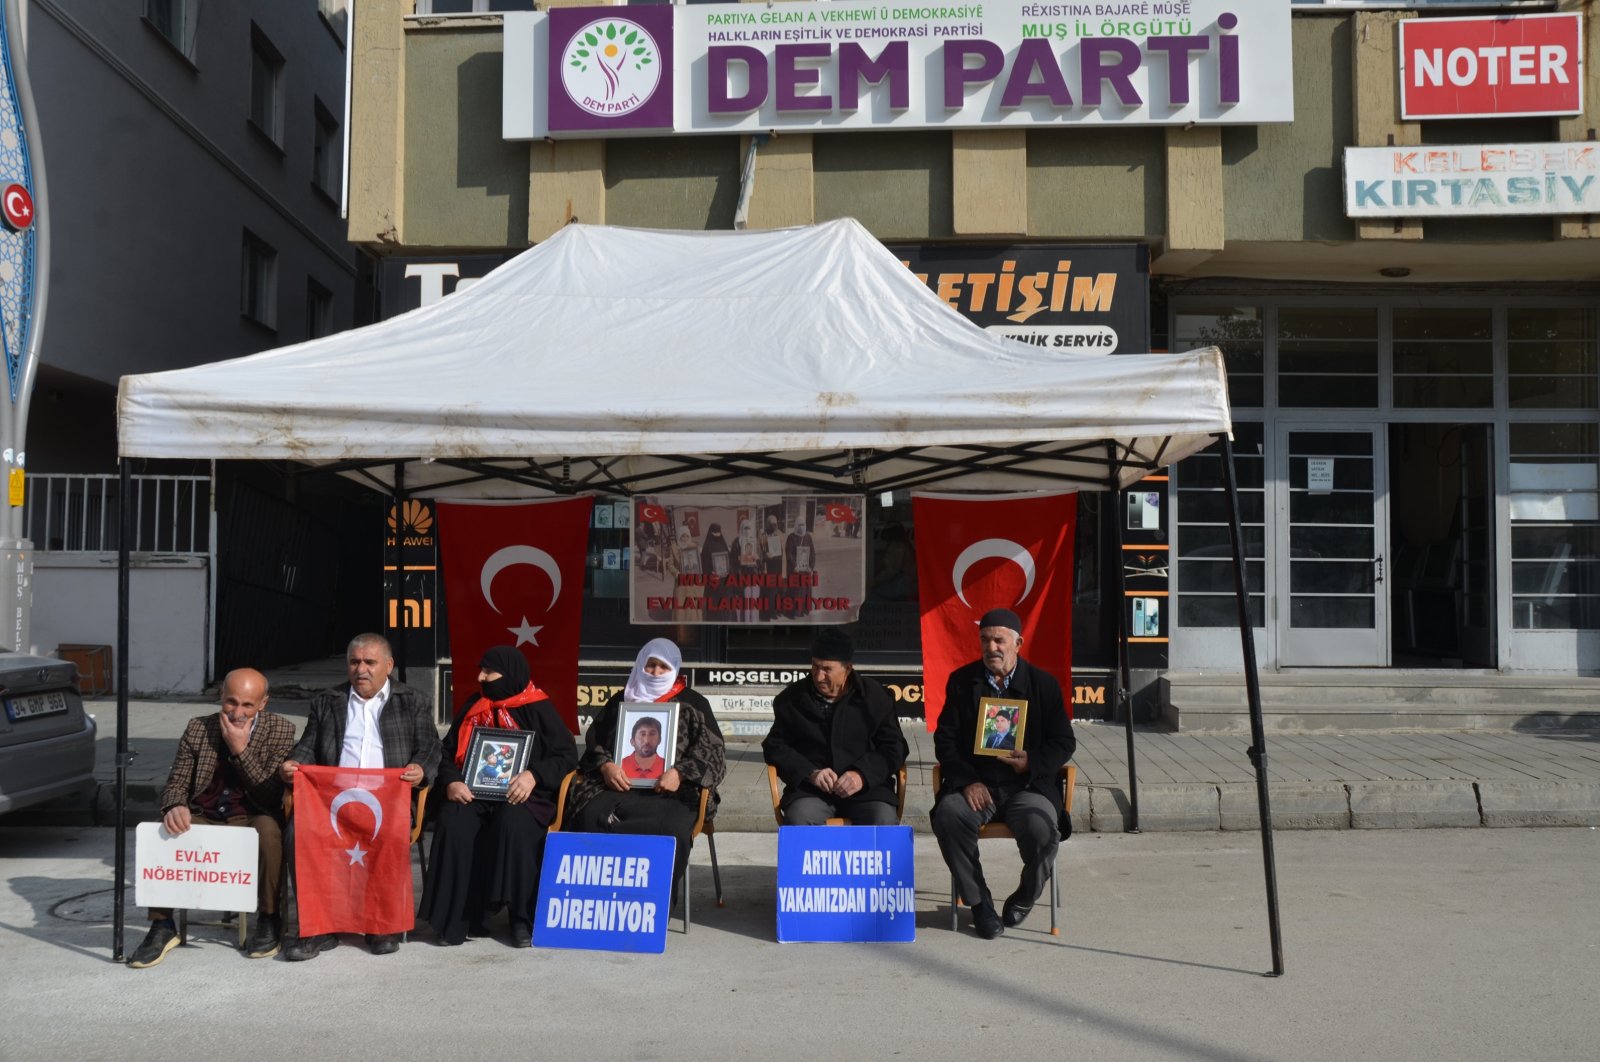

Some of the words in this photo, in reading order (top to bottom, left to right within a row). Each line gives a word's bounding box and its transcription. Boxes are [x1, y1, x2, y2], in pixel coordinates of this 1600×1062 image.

[707, 13, 757, 25] PARTIYA
[760, 11, 803, 24] GELAN
[807, 11, 817, 22] A
[880, 6, 888, 20] Û
[1021, 4, 1092, 17] RÊXISTINA
[1095, 1, 1149, 16] BAJARÊ
[708, 30, 781, 42] HALKLARIN
[784, 26, 832, 42] EŞİTLİK
[836, 28, 852, 39] VE
[855, 24, 928, 38] DEMOKRASİ
[933, 23, 983, 36] PARTİSİ
[1022, 23, 1068, 40] MUŞ
[1075, 20, 1094, 37] İL
[1100, 18, 1192, 37] ÖRGÜTÜ
[708, 41, 909, 116] DEM
[943, 12, 1240, 108] PARTİ
[1413, 45, 1570, 87] NOTER
[582, 96, 606, 112] DEM
[608, 93, 640, 112] PARTİ
[1053, 331, 1114, 348] SERVİS
[387, 537, 433, 546] HAWEI
[677, 573, 720, 590] MUŞ
[725, 572, 819, 588] ANNELERİ
[646, 596, 769, 611] EVLATLARINI
[775, 596, 851, 611] İSTİYOR
[13, 700, 26, 716] 34
[175, 850, 220, 863] EVLAT
[802, 850, 842, 875] ARTIK
[845, 850, 883, 875] YETER
[143, 866, 251, 885] NÖBETİNDEYİZ
[555, 854, 650, 888] ANNELER
[778, 887, 866, 913] YAKAMIZDAN
[869, 880, 914, 921] DÜŞÜN
[546, 889, 657, 934] DİRENİYOR
